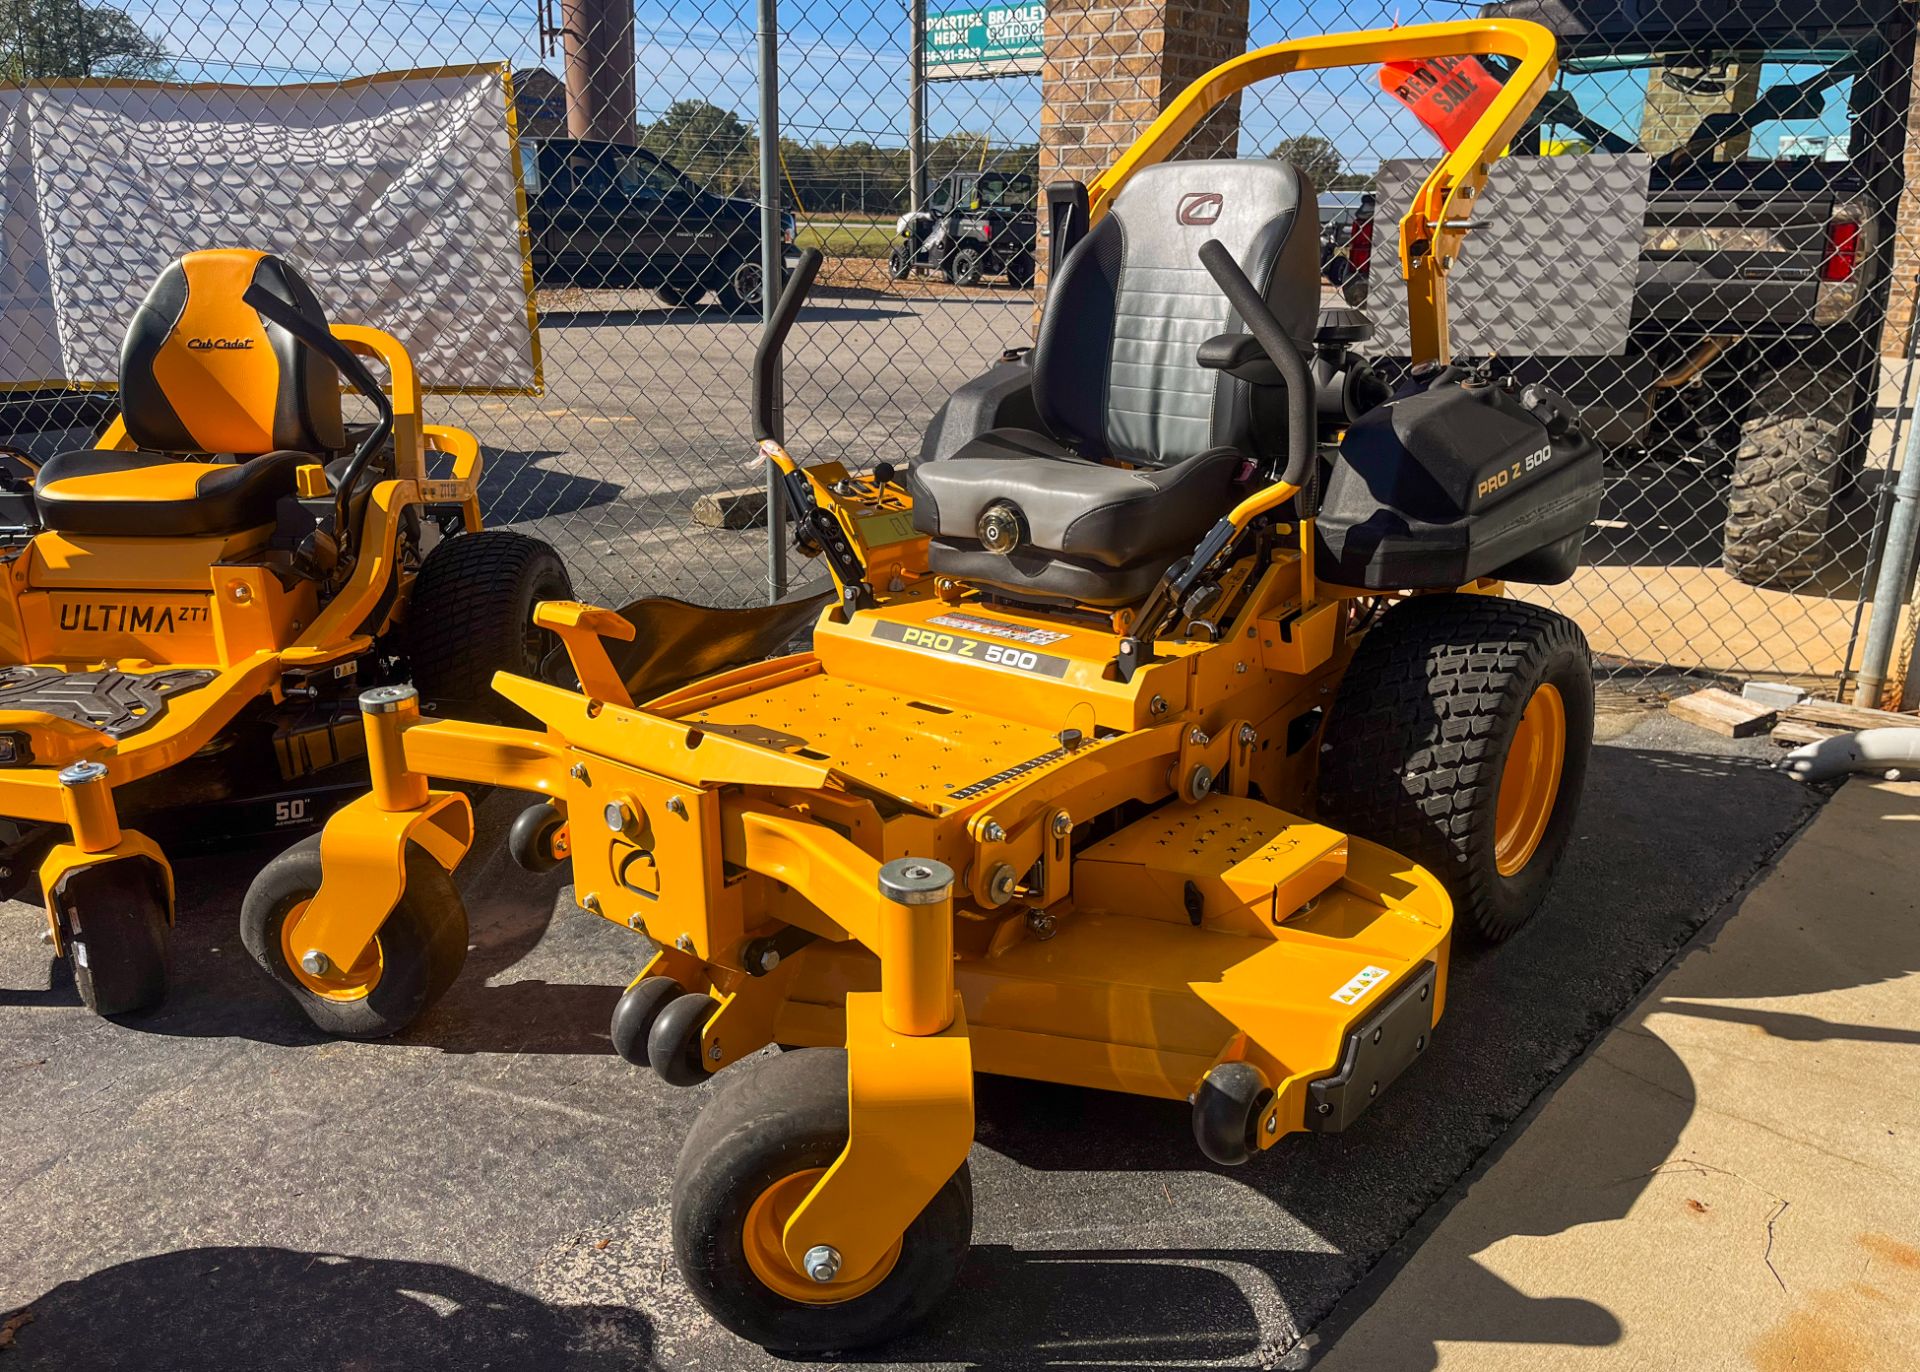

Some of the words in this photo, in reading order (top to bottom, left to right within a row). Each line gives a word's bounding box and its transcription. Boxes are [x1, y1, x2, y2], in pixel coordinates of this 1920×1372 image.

[921, 12, 983, 31] DVERTISE
[1394, 67, 1438, 105] RED
[1432, 70, 1478, 113] SALE
[187, 338, 213, 349] Cub
[214, 338, 254, 349] Cadet
[1478, 469, 1508, 499] PRO
[1511, 461, 1522, 480] Z
[1525, 444, 1551, 472] 500
[59, 604, 175, 632] ULTIMA
[178, 607, 209, 622] ZT1
[902, 627, 953, 651] PRO
[957, 640, 978, 657] Z
[984, 645, 1038, 670] 500
